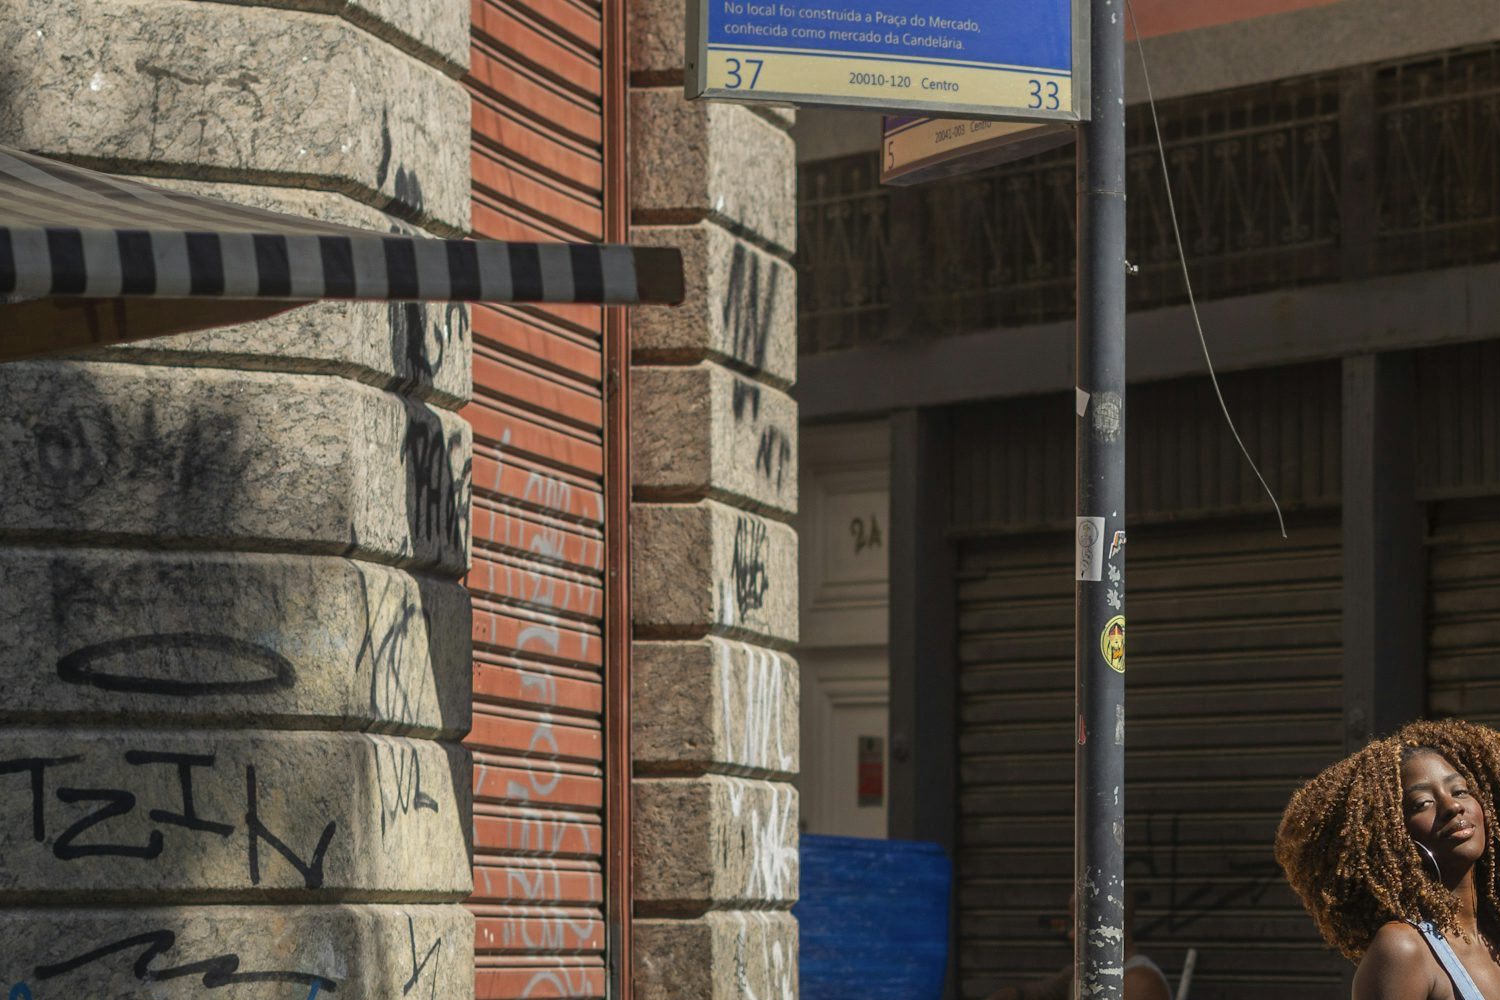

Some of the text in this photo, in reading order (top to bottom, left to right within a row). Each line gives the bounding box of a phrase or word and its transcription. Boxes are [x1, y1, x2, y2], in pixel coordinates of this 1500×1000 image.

[724, 1, 743, 14] No
[747, 2, 776, 16] local
[780, 4, 796, 17] foi
[864, 13, 873, 23] a
[875, 11, 907, 27] Praça
[910, 14, 926, 27] do
[929, 16, 981, 33] Mercado,
[724, 22, 965, 50] conhecida como mercado da Candelária.
[725, 58, 764, 89] 37
[849, 72, 960, 92] 20010-120 Centro
[1028, 79, 1060, 110] 33
[888, 141, 895, 170] 5
